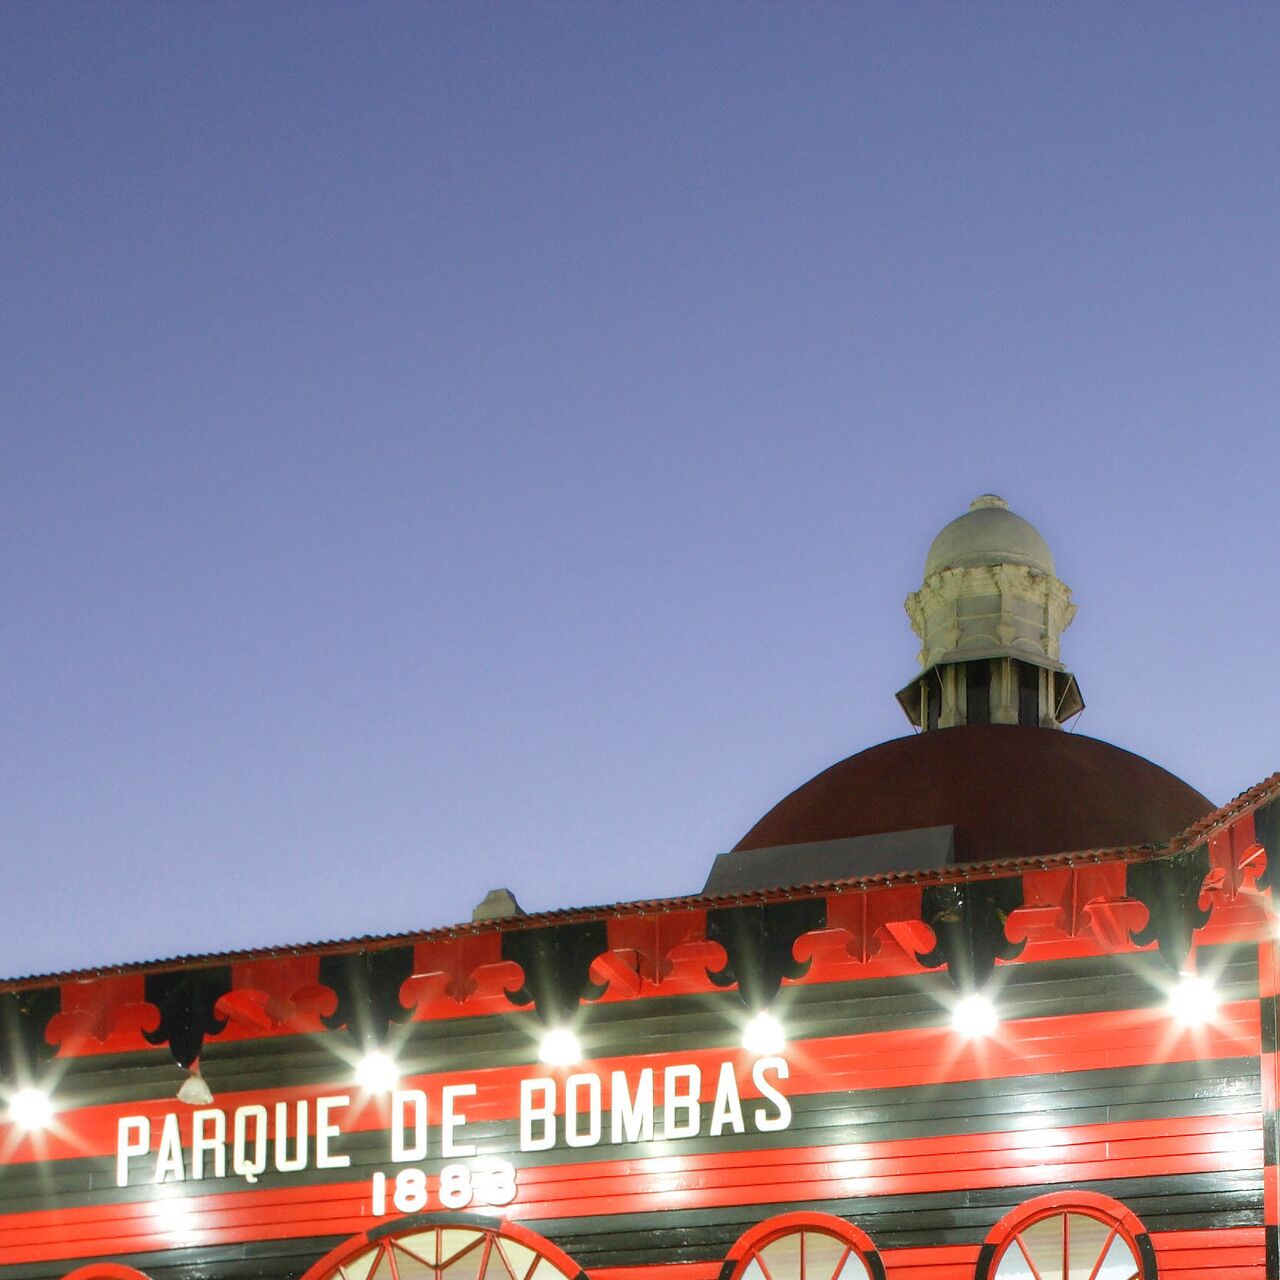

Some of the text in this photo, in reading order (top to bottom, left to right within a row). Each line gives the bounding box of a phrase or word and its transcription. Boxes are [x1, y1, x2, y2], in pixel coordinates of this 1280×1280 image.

[117, 1056, 792, 1187] PARQUE DE BOMBAS
